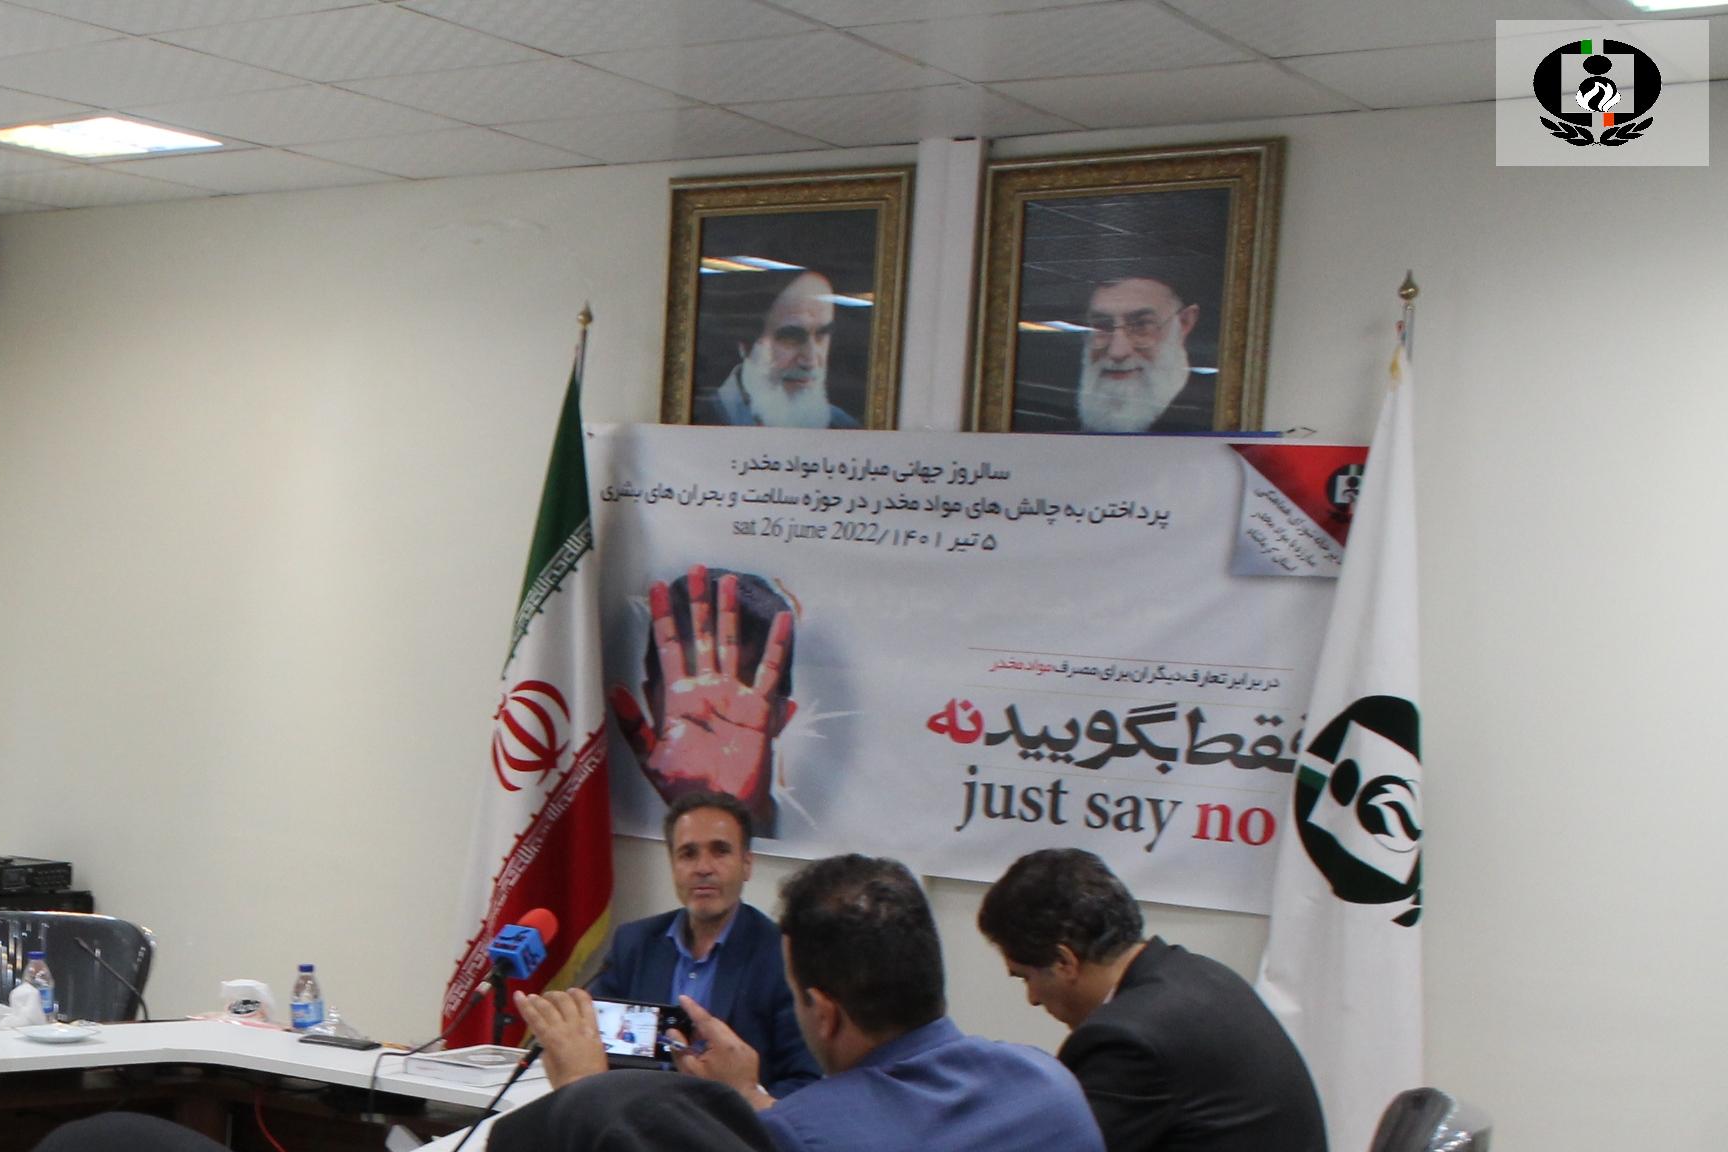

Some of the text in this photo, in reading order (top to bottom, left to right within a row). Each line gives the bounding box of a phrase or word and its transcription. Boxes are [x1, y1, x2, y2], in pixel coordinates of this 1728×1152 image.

[785, 455, 819, 478] مواد
[822, 456, 834, 480] با
[838, 457, 890, 481] مبارزه
[893, 460, 944, 485] جهانی
[947, 461, 1011, 485] سالروز
[677, 483, 723, 508] بحران
[728, 492, 737, 508] و
[741, 487, 798, 506] سلامت
[803, 489, 841, 512] حوزه
[846, 494, 866, 514] در
[872, 493, 919, 515] مخدر
[924, 494, 962, 518] مواد
[965, 498, 1002, 519] های
[1005, 498, 1060, 525] چالش
[1064, 504, 1086, 523] به
[1087, 500, 1170, 529] پرداختن
[732, 518, 757, 536] sat
[761, 517, 783, 537] 26
[785, 518, 827, 544] june
[926, 698, 984, 744] نه
[955, 764, 1277, 853] just say no
